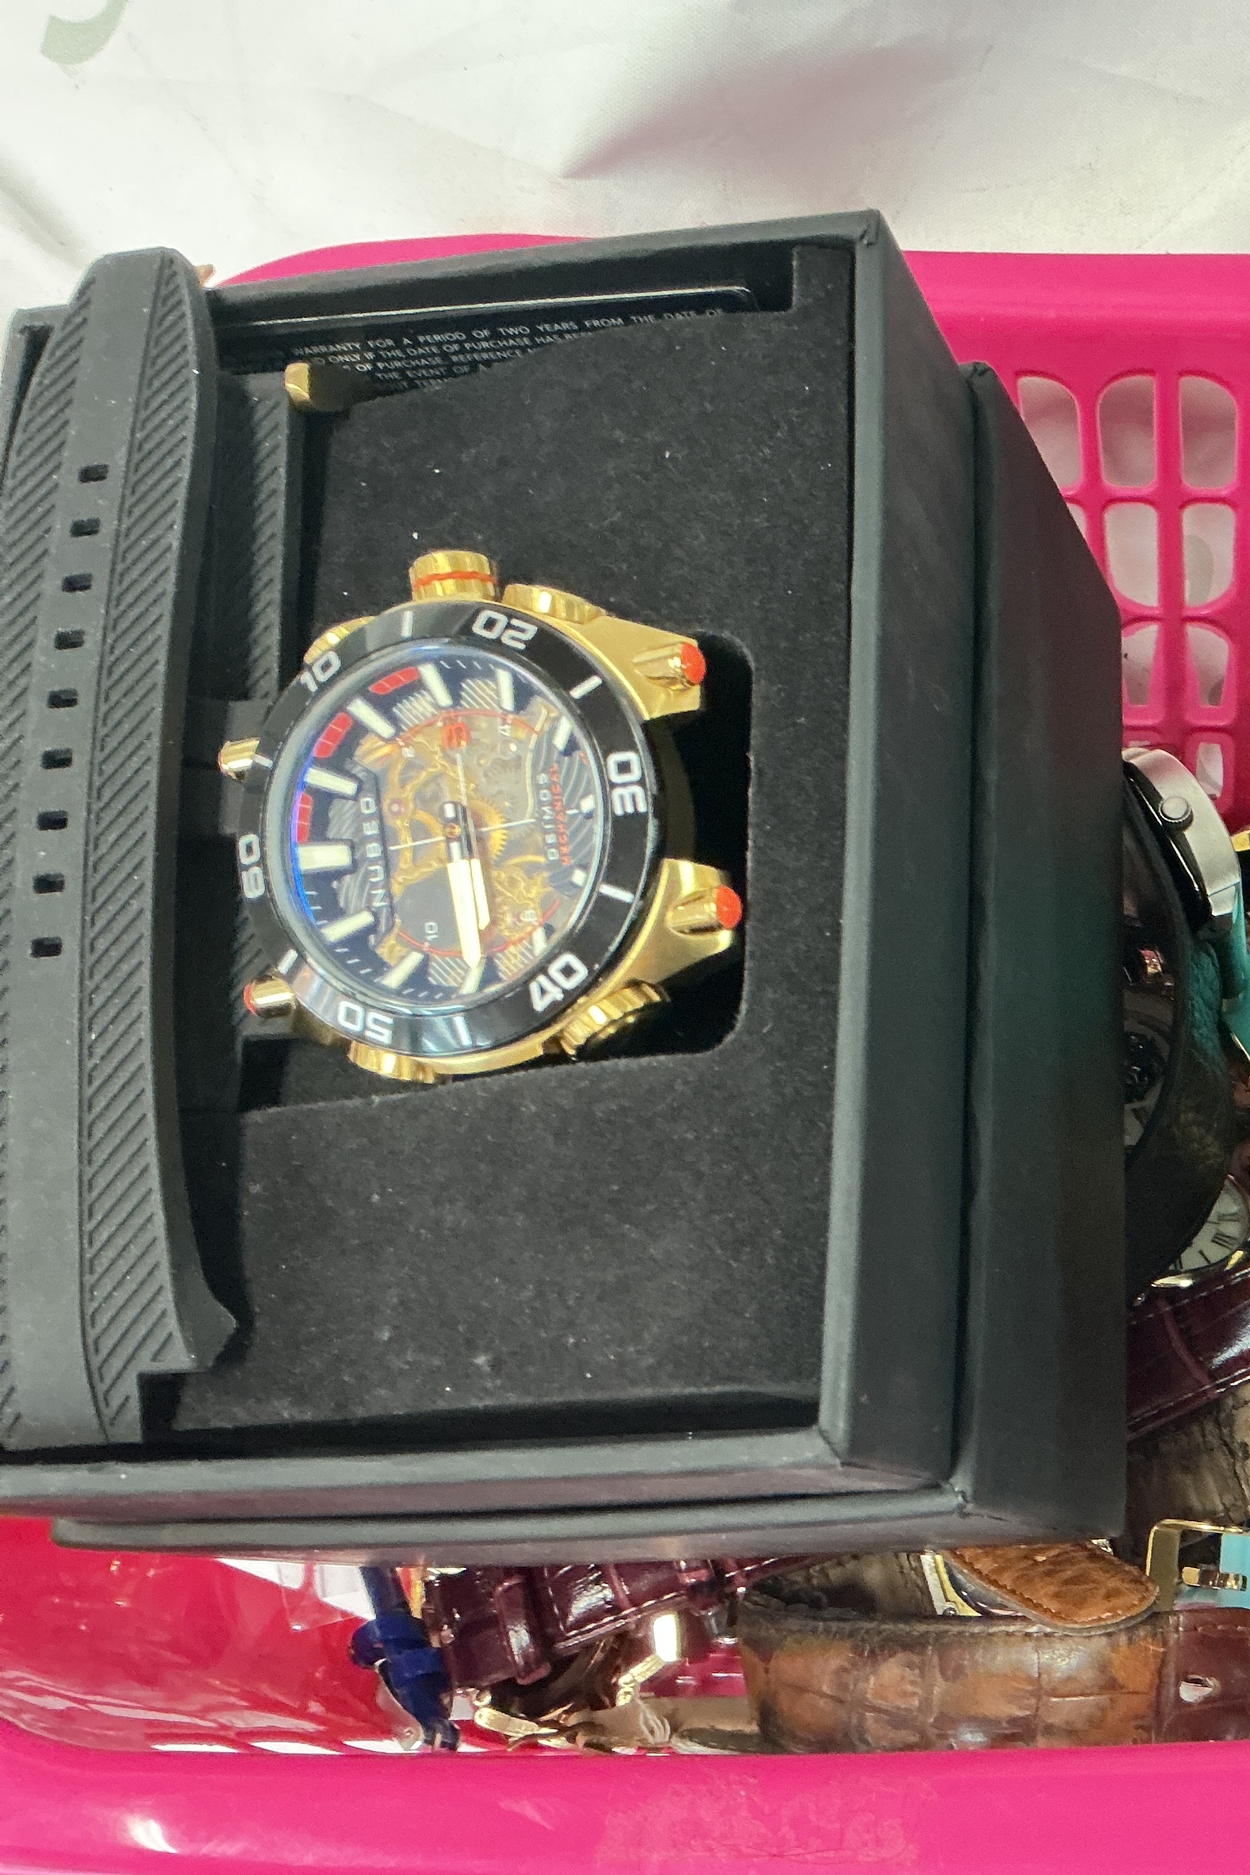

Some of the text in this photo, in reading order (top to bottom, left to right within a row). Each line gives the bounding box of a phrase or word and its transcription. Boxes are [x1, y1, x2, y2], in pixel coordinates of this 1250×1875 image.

[293, 341, 361, 356] WARRANTY
[367, 338, 396, 349] FOR
[402, 337, 412, 345] A
[417, 331, 466, 343] PERIOD
[471, 329, 491, 339] OF
[498, 325, 531, 336] TWO
[536, 321, 578, 333] YEARS
[584, 317, 625, 329] FROM
[630, 313, 656, 324] THE
[327, 351, 361, 364] ONLY
[363, 350, 376, 361] IF
[379, 349, 405, 359] THE
[407, 345, 439, 356] DATE
[442, 343, 461, 353] OF
[464, 336, 533, 350] PURCHASE
[534, 334, 562, 345] HAS
[355, 362, 374, 372] OF
[377, 356, 443, 370] PURCHASE
[405, 367, 448, 379] EVENT
[299, 649, 342, 693] 10
[606, 750, 648, 817] 30
[238, 833, 267, 900] 60
[528, 952, 589, 1013] 40
